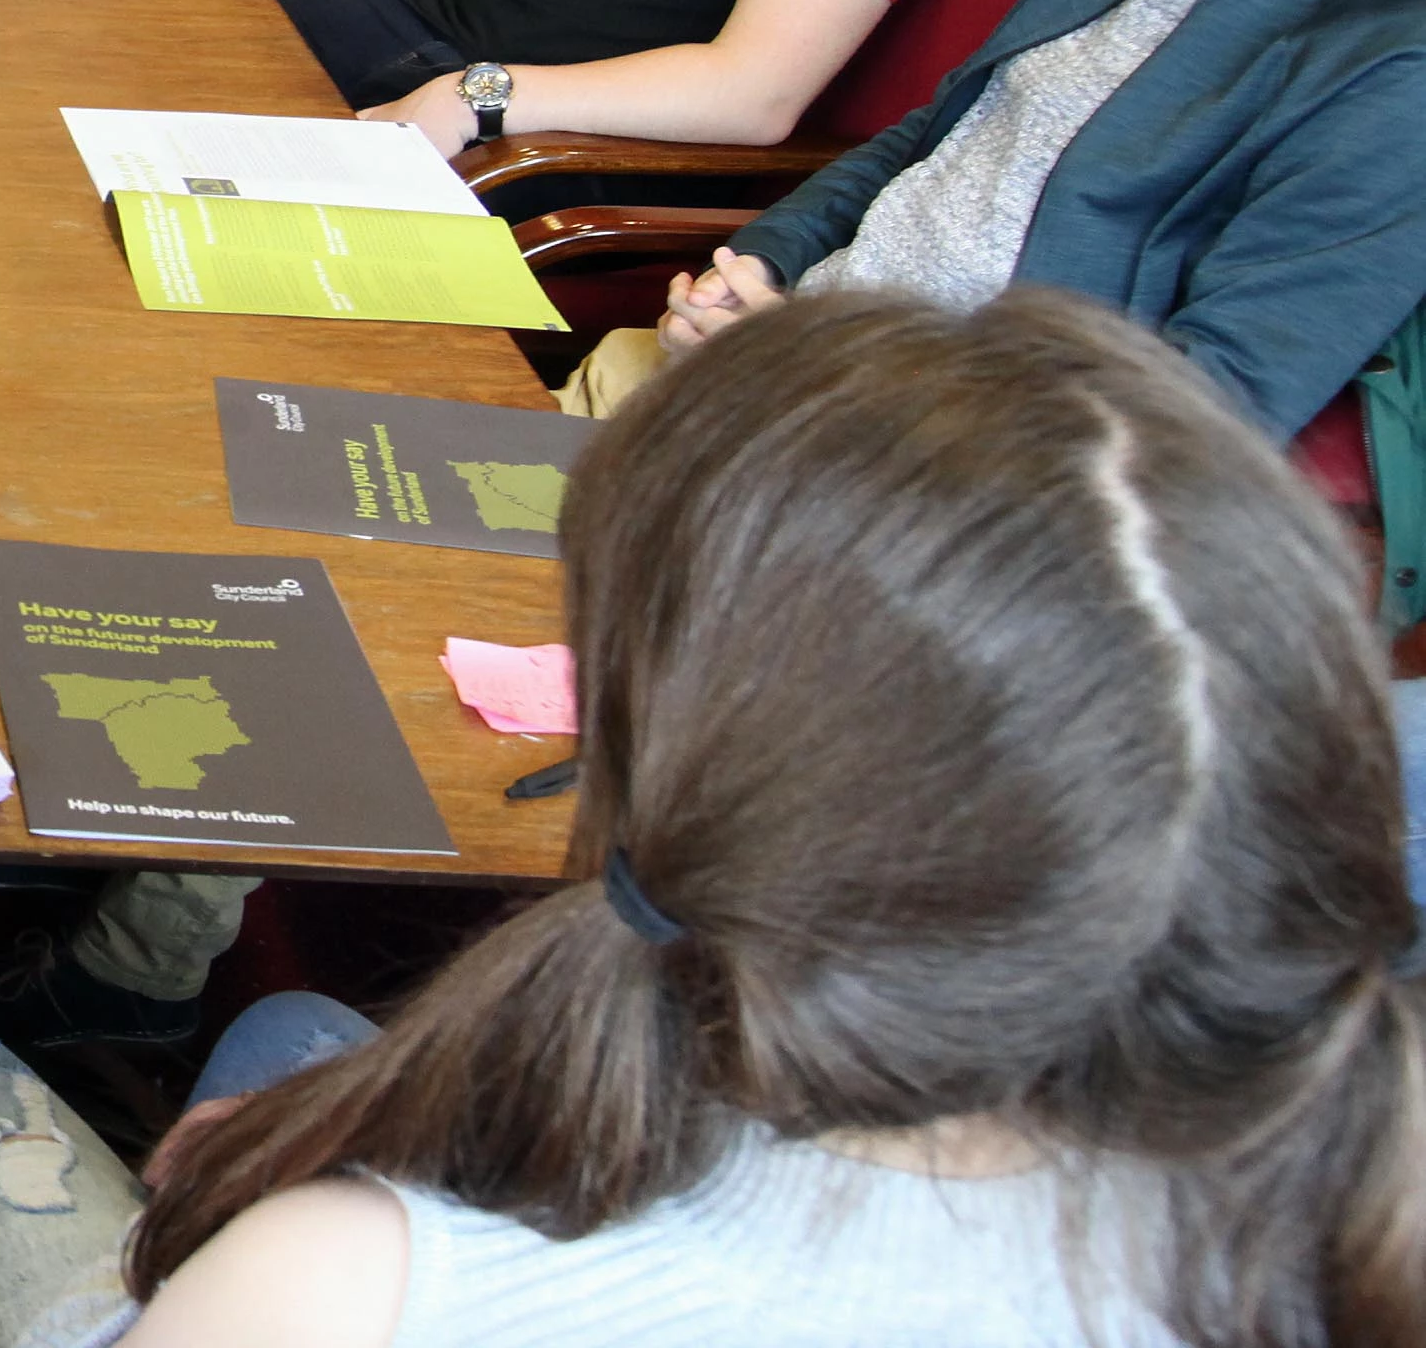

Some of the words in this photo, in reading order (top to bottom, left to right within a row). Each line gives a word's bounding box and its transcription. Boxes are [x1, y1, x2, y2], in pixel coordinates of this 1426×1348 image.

[273, 395, 291, 431] Sunderland
[343, 439, 369, 460] say
[371, 424, 397, 475] development
[349, 462, 379, 490] your
[385, 474, 404, 498] future
[355, 490, 381, 520] Have
[390, 497, 409, 511] the
[401, 471, 429, 516] Sunderland
[397, 510, 412, 523] on
[411, 514, 432, 525] of
[212, 582, 304, 597] Sunderland
[215, 593, 240, 603] City
[239, 594, 287, 603] Council
[19, 601, 92, 622] Have
[96, 609, 162, 629] your
[167, 615, 218, 634] say
[23, 623, 50, 634] on
[52, 624, 85, 637] the
[86, 626, 147, 644] future
[149, 632, 278, 651] development
[25, 632, 48, 644] of
[49, 634, 161, 655] Sunderland
[67, 798, 112, 815] Help
[115, 803, 138, 815] us
[139, 804, 194, 821] shape
[197, 810, 230, 822] our
[231, 810, 296, 826] future.
